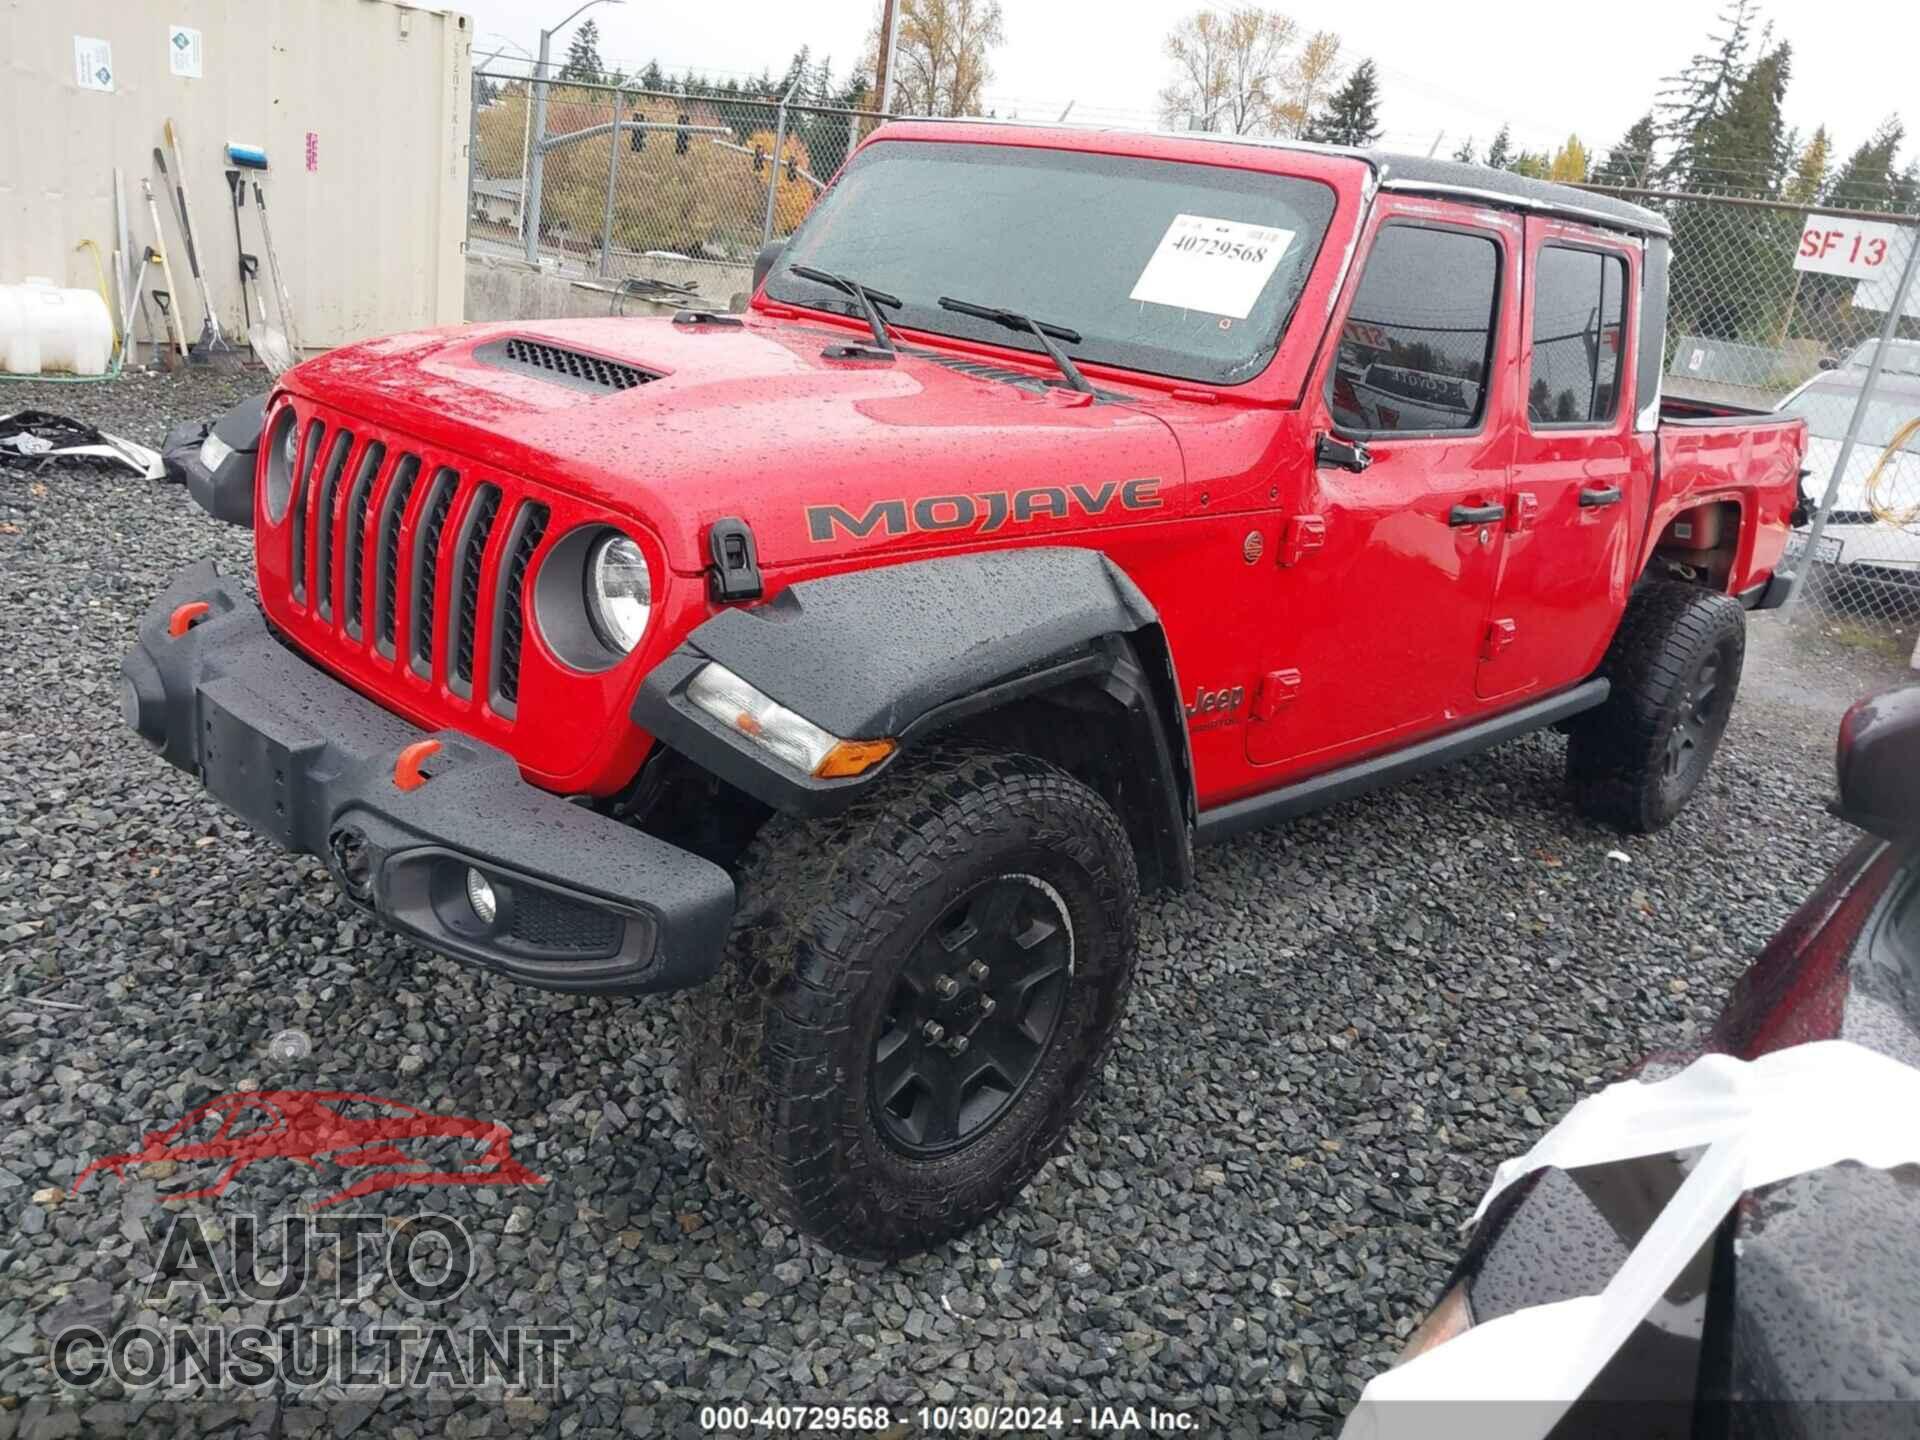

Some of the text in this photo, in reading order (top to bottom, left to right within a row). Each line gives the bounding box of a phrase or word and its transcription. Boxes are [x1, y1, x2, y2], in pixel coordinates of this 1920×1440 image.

[1171, 234, 1269, 263] 40729568
[1799, 229, 1888, 267] SF 13
[805, 477, 1164, 544] MOJAVE
[1184, 685, 1245, 716] Jeep
